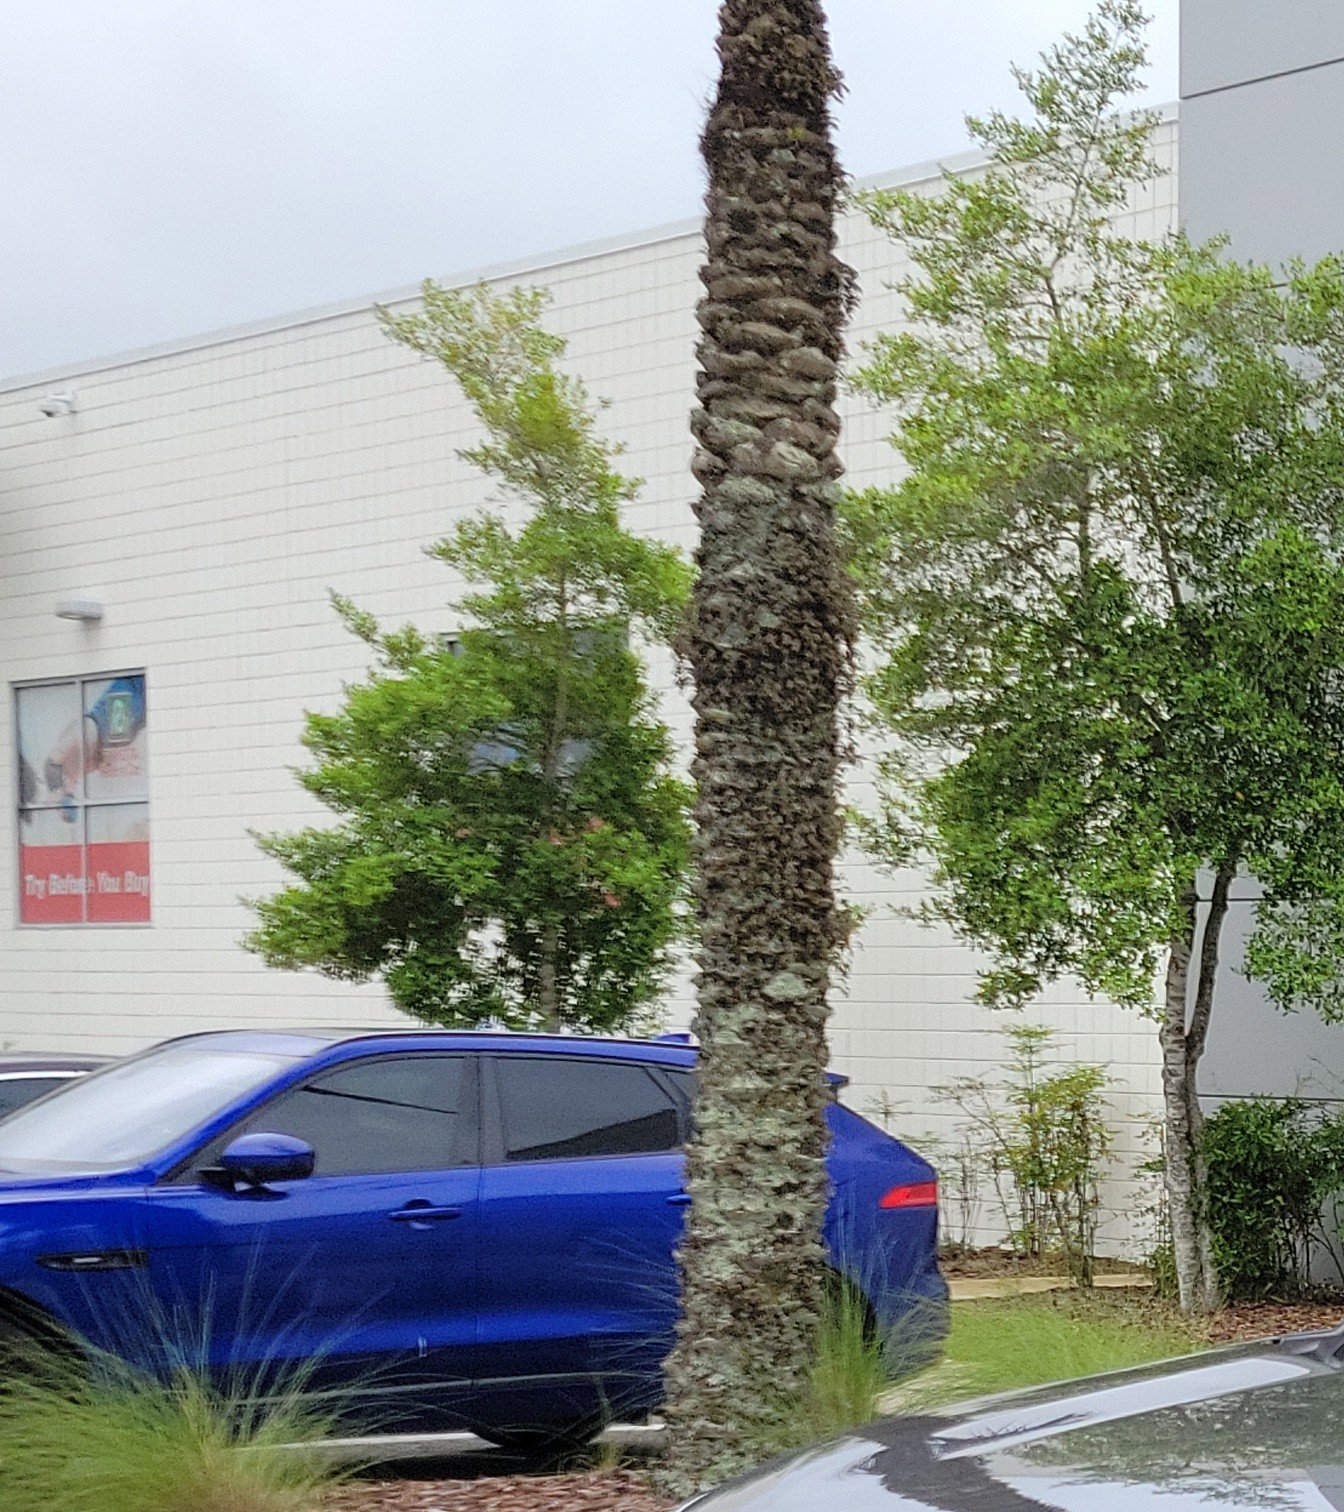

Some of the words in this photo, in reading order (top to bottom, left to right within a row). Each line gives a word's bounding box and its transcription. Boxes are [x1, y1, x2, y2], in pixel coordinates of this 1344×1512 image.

[24, 874, 46, 899] Try
[49, 872, 94, 895] Before
[97, 870, 121, 893] You
[124, 870, 149, 897] Buy
